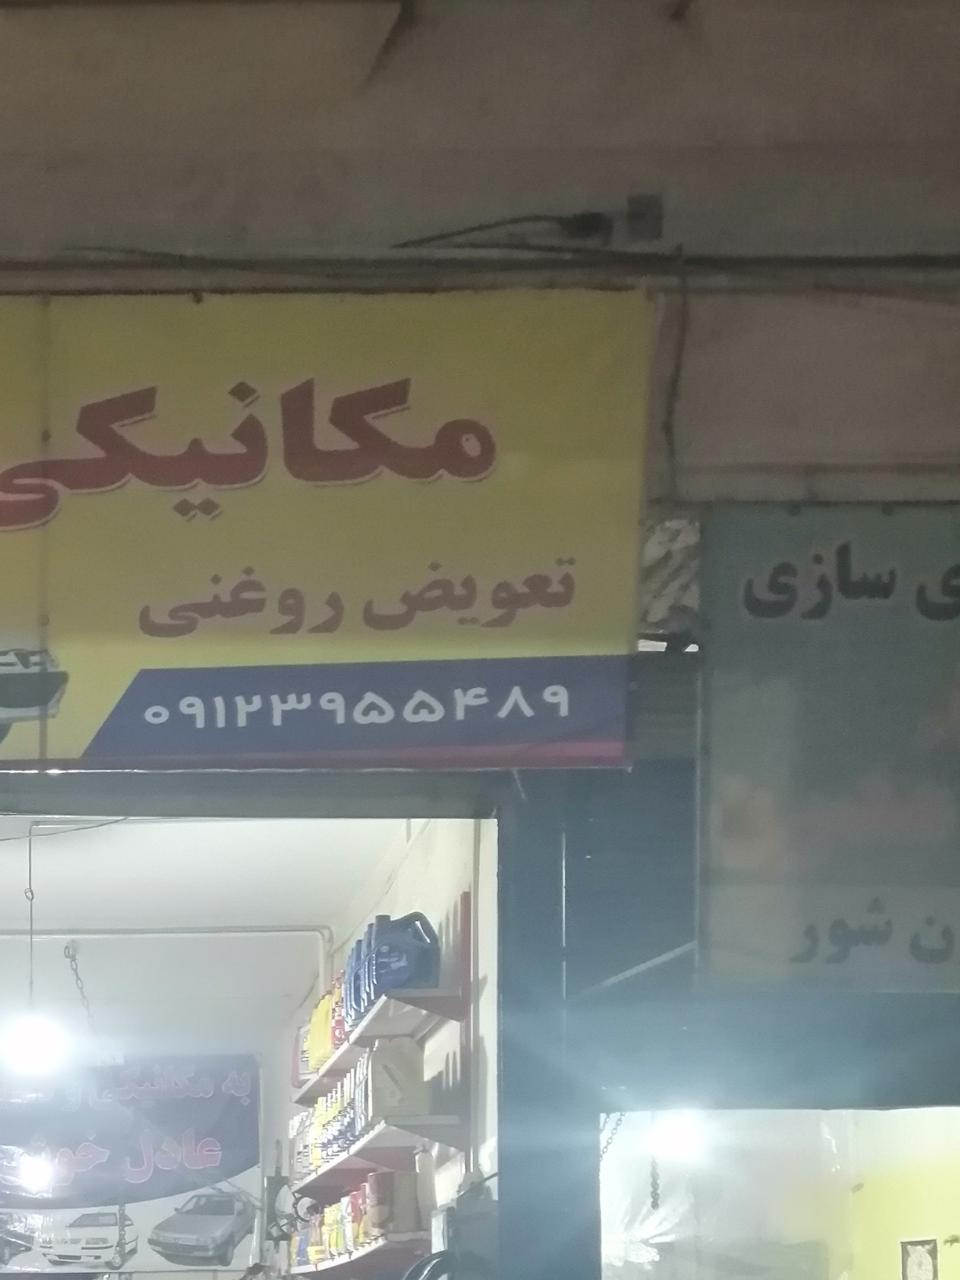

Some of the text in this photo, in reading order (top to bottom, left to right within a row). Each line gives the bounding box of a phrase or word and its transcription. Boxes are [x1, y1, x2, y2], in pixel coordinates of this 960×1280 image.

[139, 556, 577, 638] تعویض روغنی
[743, 542, 897, 620] سازی
[143, 683, 569, 729] ۰۹۱۲۳۹۵۵۴۸۹
[124, 1128, 223, 1184] عادل
